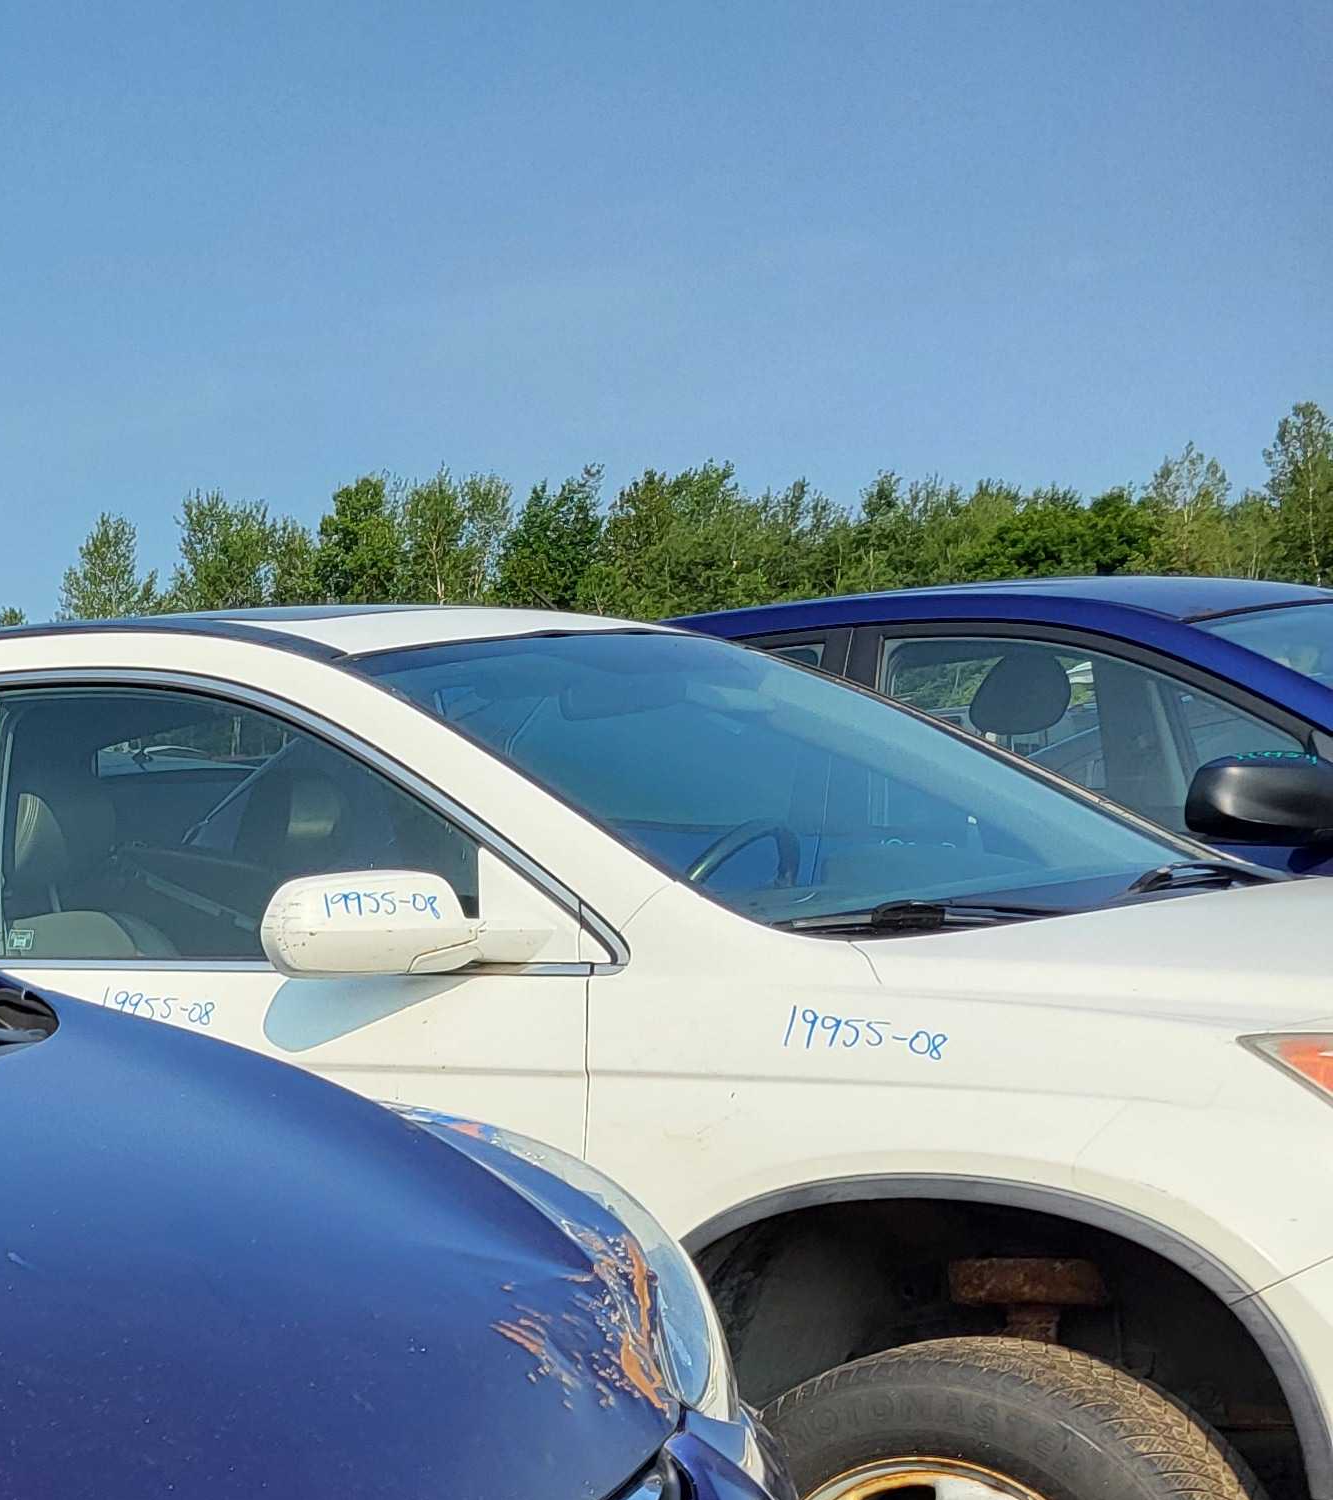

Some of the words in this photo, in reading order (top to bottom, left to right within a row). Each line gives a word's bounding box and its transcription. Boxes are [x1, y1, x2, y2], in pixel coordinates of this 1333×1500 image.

[323, 890, 441, 920] 19955-08
[102, 986, 216, 1026] 19955-08
[783, 1005, 949, 1061] 19955-08
